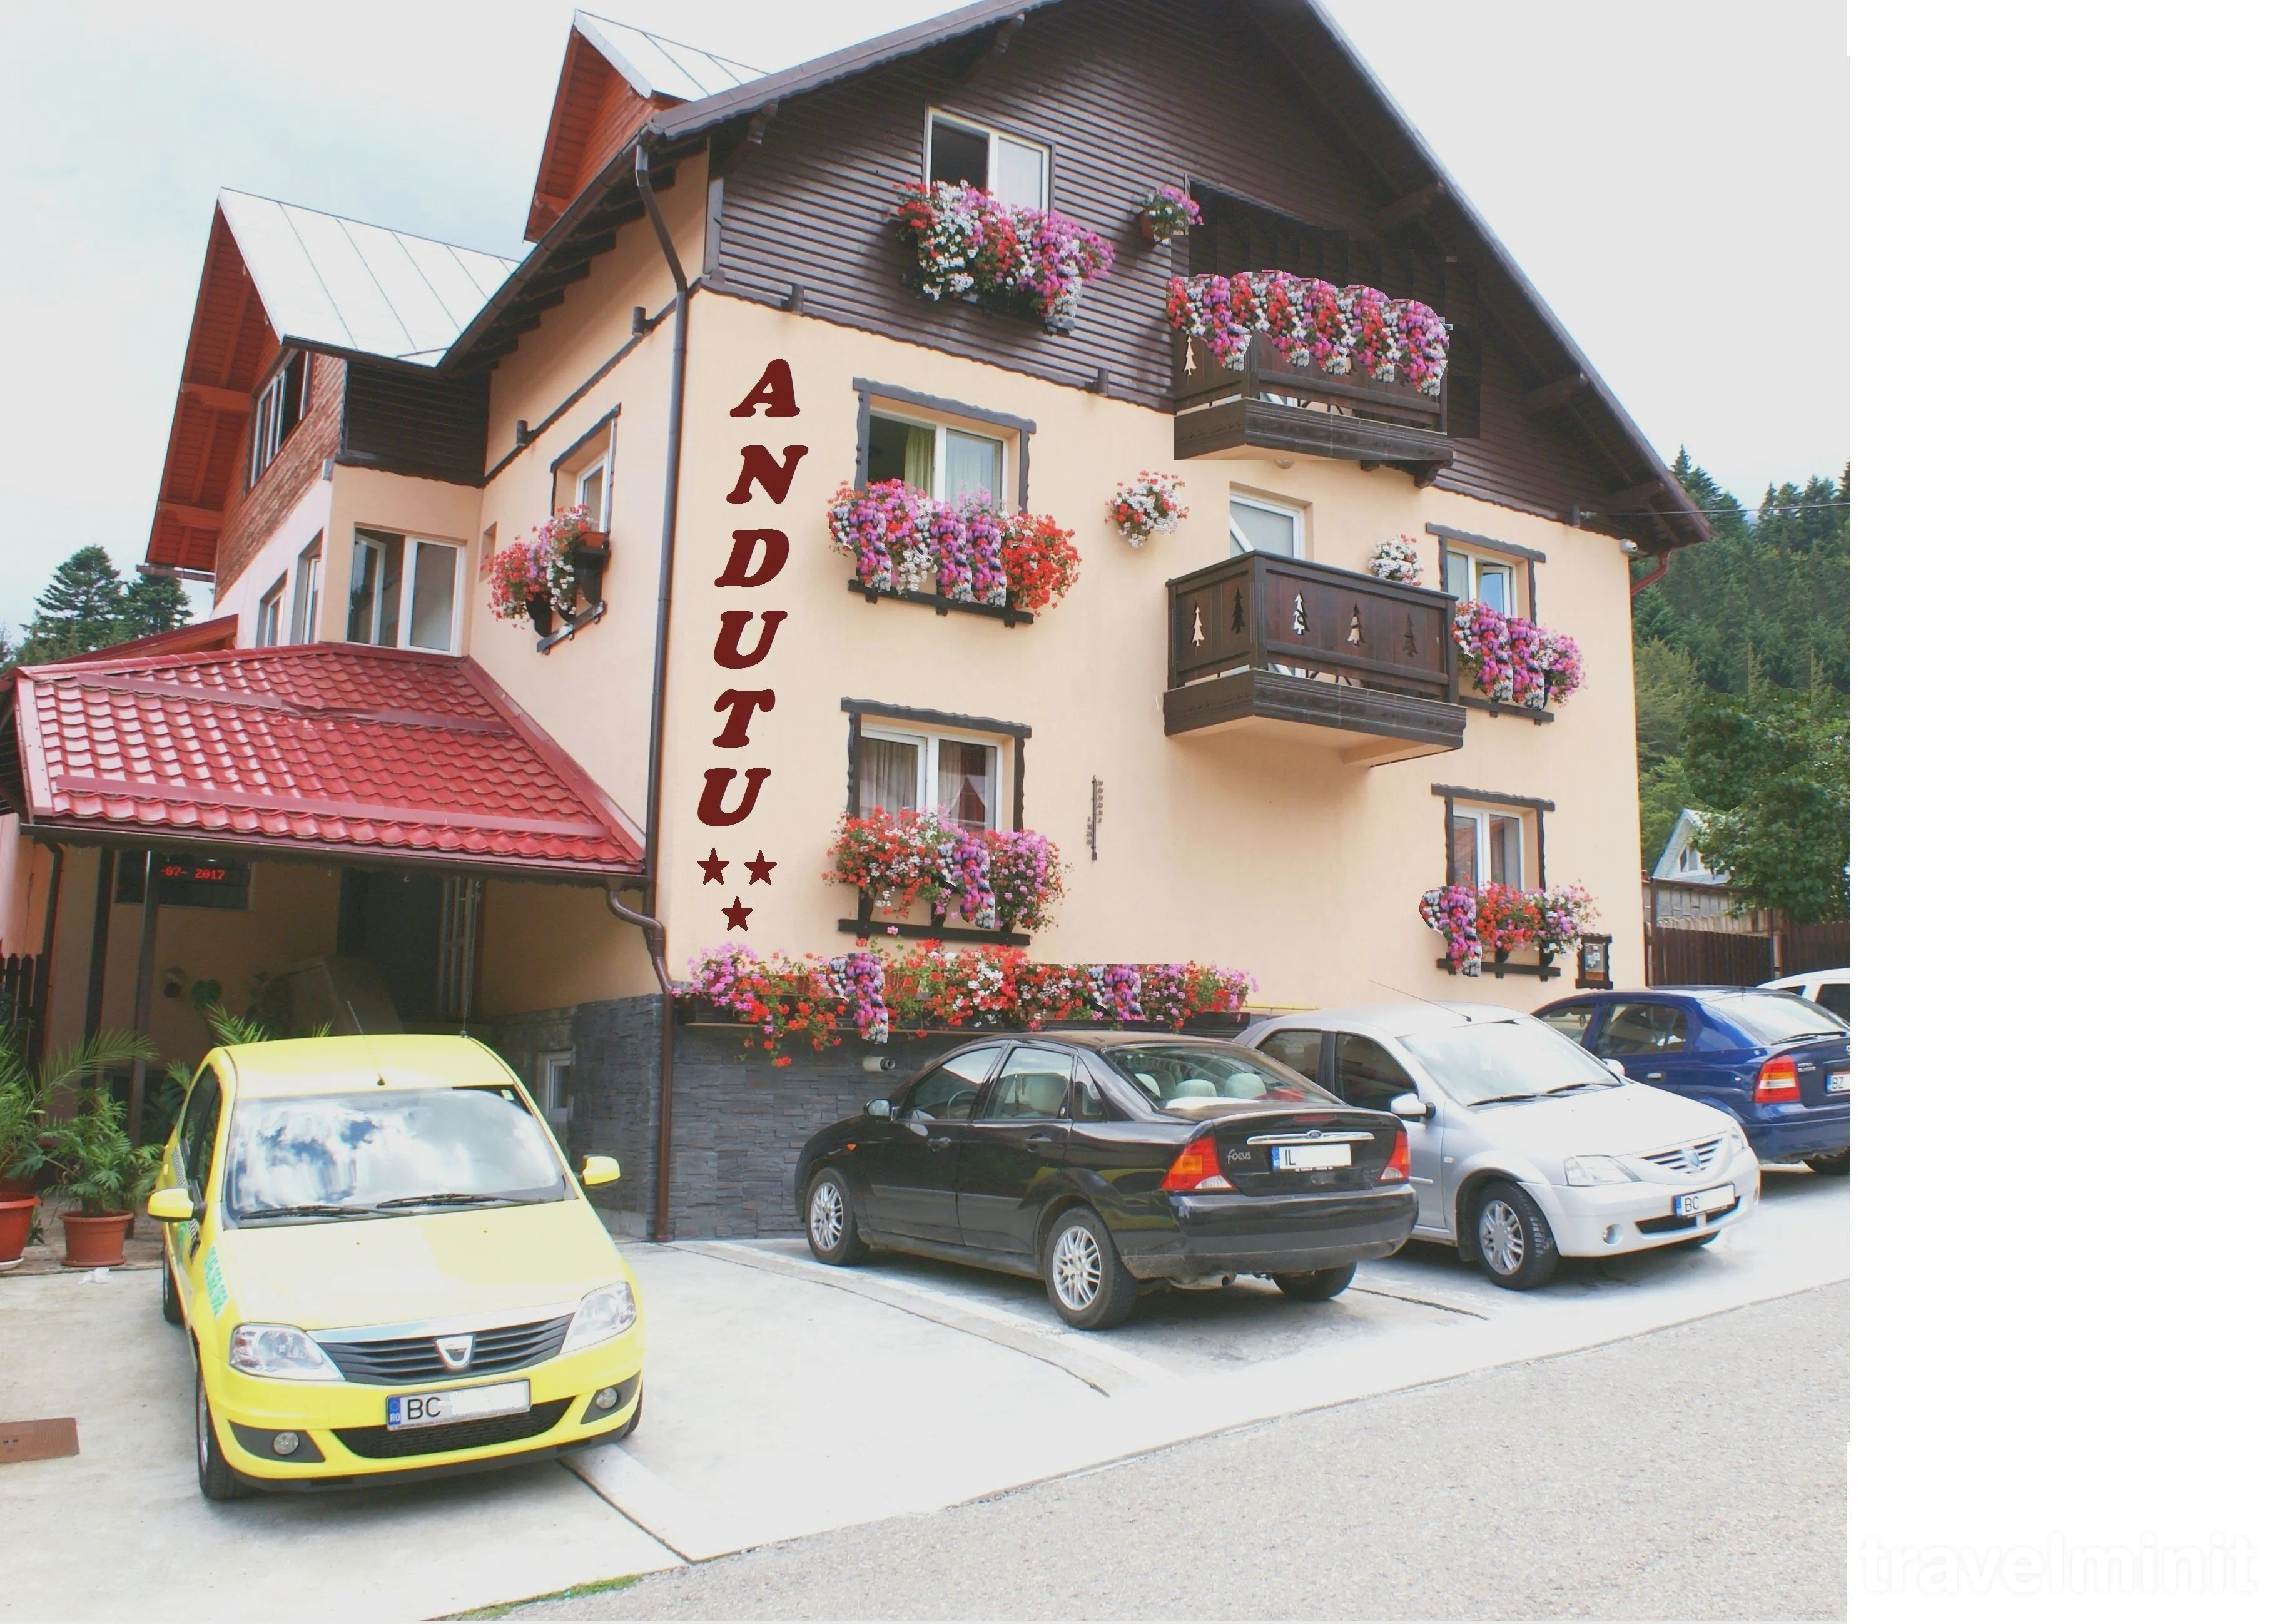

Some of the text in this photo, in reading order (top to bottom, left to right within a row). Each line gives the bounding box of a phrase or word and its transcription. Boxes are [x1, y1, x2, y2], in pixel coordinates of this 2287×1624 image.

[697, 358, 809, 826] ANDUTU
[195, 868, 226, 880] 2017
[1832, 1076, 1844, 1089] BZ
[1285, 1149, 1296, 1166] IL
[1685, 1196, 1700, 1212] BC
[389, 1413, 400, 1422] RO
[407, 1396, 442, 1421] BC
